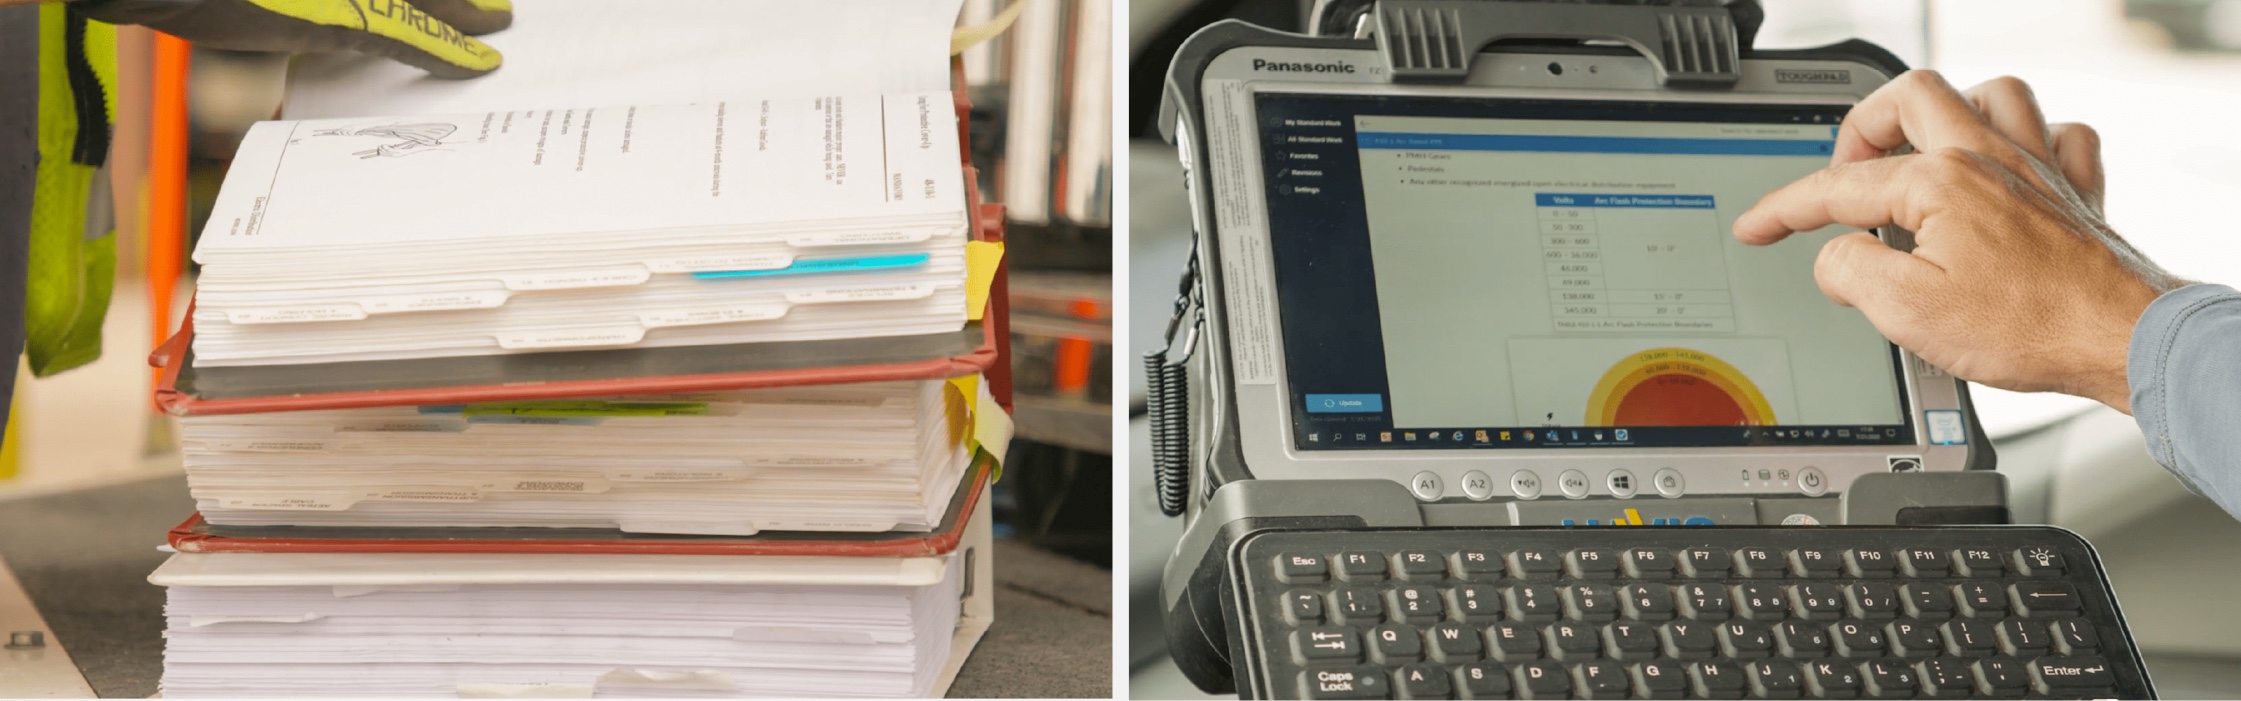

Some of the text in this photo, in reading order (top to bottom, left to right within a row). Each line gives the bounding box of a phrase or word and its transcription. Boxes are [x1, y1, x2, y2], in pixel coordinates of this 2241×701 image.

[369, 0, 478, 57] CHROME
[1252, 58, 1356, 75] Panasonic
[1779, 71, 1848, 82] TOUGHPAD
[1284, 118, 1342, 127] My Standard Work
[1287, 135, 1343, 144] All Standard Work
[1289, 152, 1320, 160] Favorites
[1291, 168, 1323, 177] Revisions
[1294, 186, 1321, 195] Settings
[1552, 196, 1575, 205] Volts
[1594, 196, 1713, 207] Arc Flash Protection Boundary
[1338, 399, 1363, 408] Update
[1420, 479, 1436, 490] A1
[1469, 479, 1486, 490] A2
[1349, 554, 1366, 564] F1
[1408, 553, 1426, 563] F2
[1467, 552, 1485, 562] F3
[1524, 552, 1542, 561] F4
[1581, 551, 1599, 561] F5
[1637, 551, 1655, 561] F6
[1693, 551, 1710, 560] F7
[1749, 550, 1767, 560] F8
[1804, 550, 1822, 560] F9
[1859, 550, 1881, 560] F10
[1914, 550, 1935, 560] F11
[1968, 550, 1991, 560] F12
[1292, 556, 1317, 566] Esc
[1408, 600, 1419, 611] 2
[1467, 599, 1478, 610] 3
[1584, 598, 1594, 608] 5
[1442, 628, 1459, 640] W
[1501, 627, 1515, 639] E
[1560, 626, 1574, 637] R
[1618, 625, 1629, 637] T
[1675, 625, 1687, 636] Y
[1732, 625, 1744, 636] U
[1844, 624, 1857, 635] O
[1900, 624, 1911, 635] P
[1382, 630, 1397, 642] Q
[1470, 667, 1484, 680] S
[1529, 666, 1543, 679] D
[1588, 666, 1599, 678] F
[1646, 665, 1660, 677] G
[1704, 664, 1719, 676] H
[1762, 664, 1772, 676] J
[1819, 664, 1833, 675] K
[1876, 664, 1888, 675] L
[2042, 665, 2081, 676] Enter
[1317, 671, 1354, 682] Caps
[1410, 670, 1424, 681] A
[1843, 674, 1853, 684] 2
[1320, 681, 1353, 692] Lock
